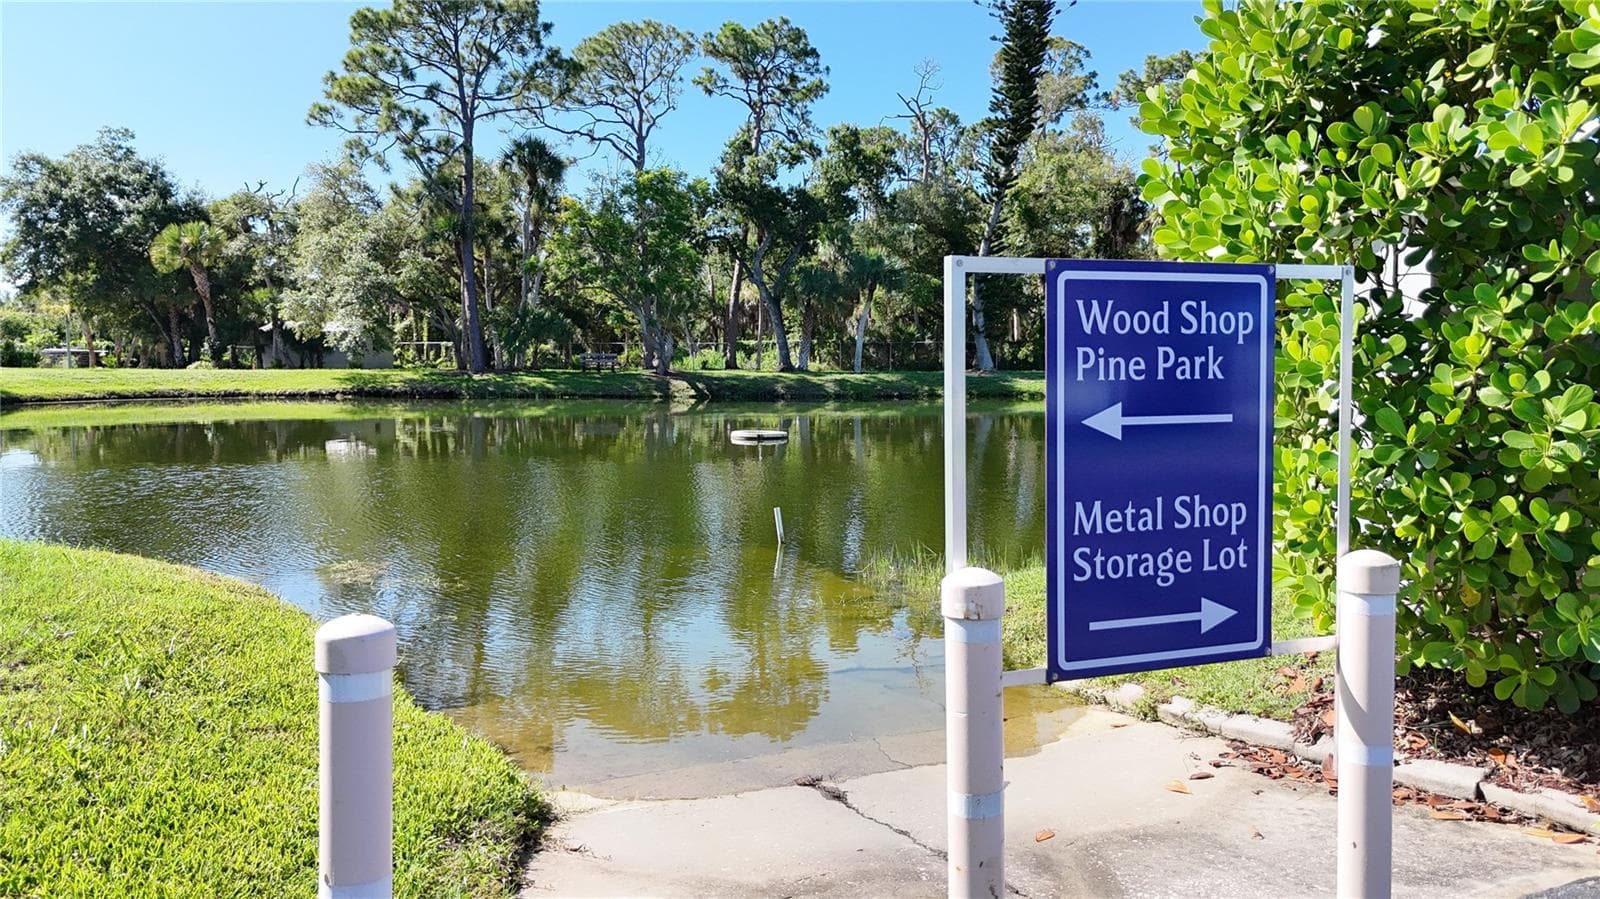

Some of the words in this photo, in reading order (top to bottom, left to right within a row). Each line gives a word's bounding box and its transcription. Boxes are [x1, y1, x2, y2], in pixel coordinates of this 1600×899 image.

[1077, 299, 1169, 334] Wood
[1180, 300, 1253, 344] Shop
[1076, 347, 1146, 381] Pine
[1157, 345, 1224, 380] Park
[1073, 496, 1163, 535] Metal
[1174, 495, 1247, 535] Shop
[1073, 547, 1192, 587] Storage
[1203, 539, 1248, 571] Lot
